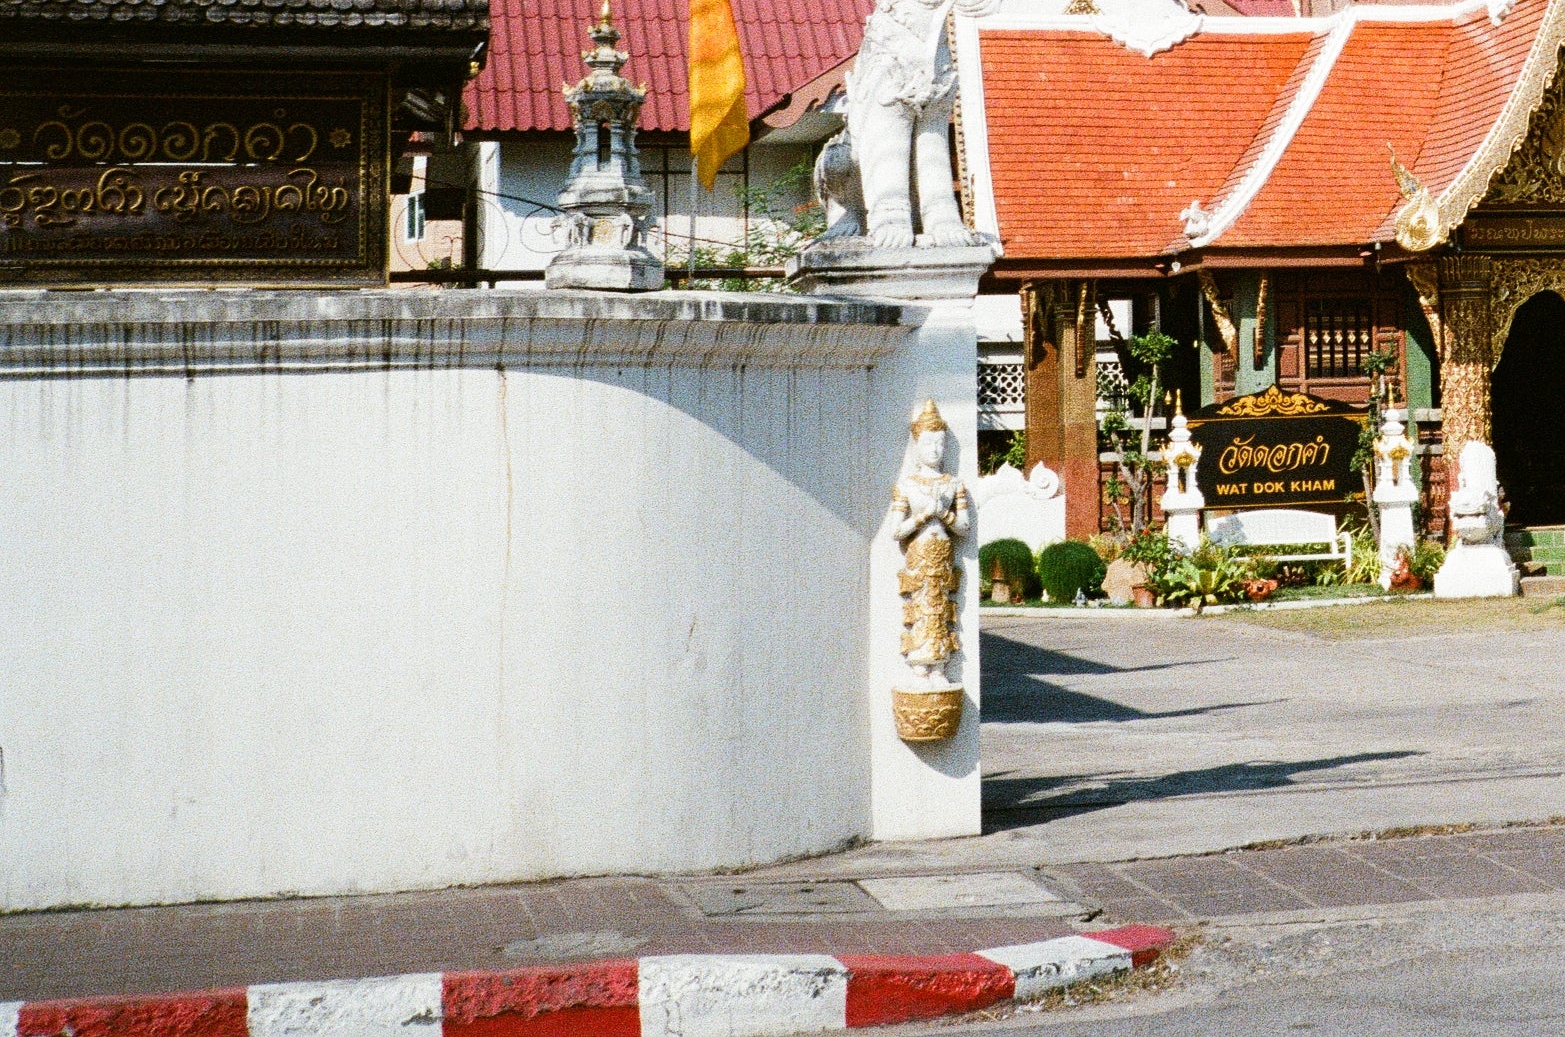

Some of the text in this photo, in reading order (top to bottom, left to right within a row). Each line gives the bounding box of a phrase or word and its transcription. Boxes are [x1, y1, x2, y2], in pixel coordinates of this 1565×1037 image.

[1218, 434, 1331, 475] วัดดอกคำ
[1216, 479, 1336, 496] WAT DOK KHAM
